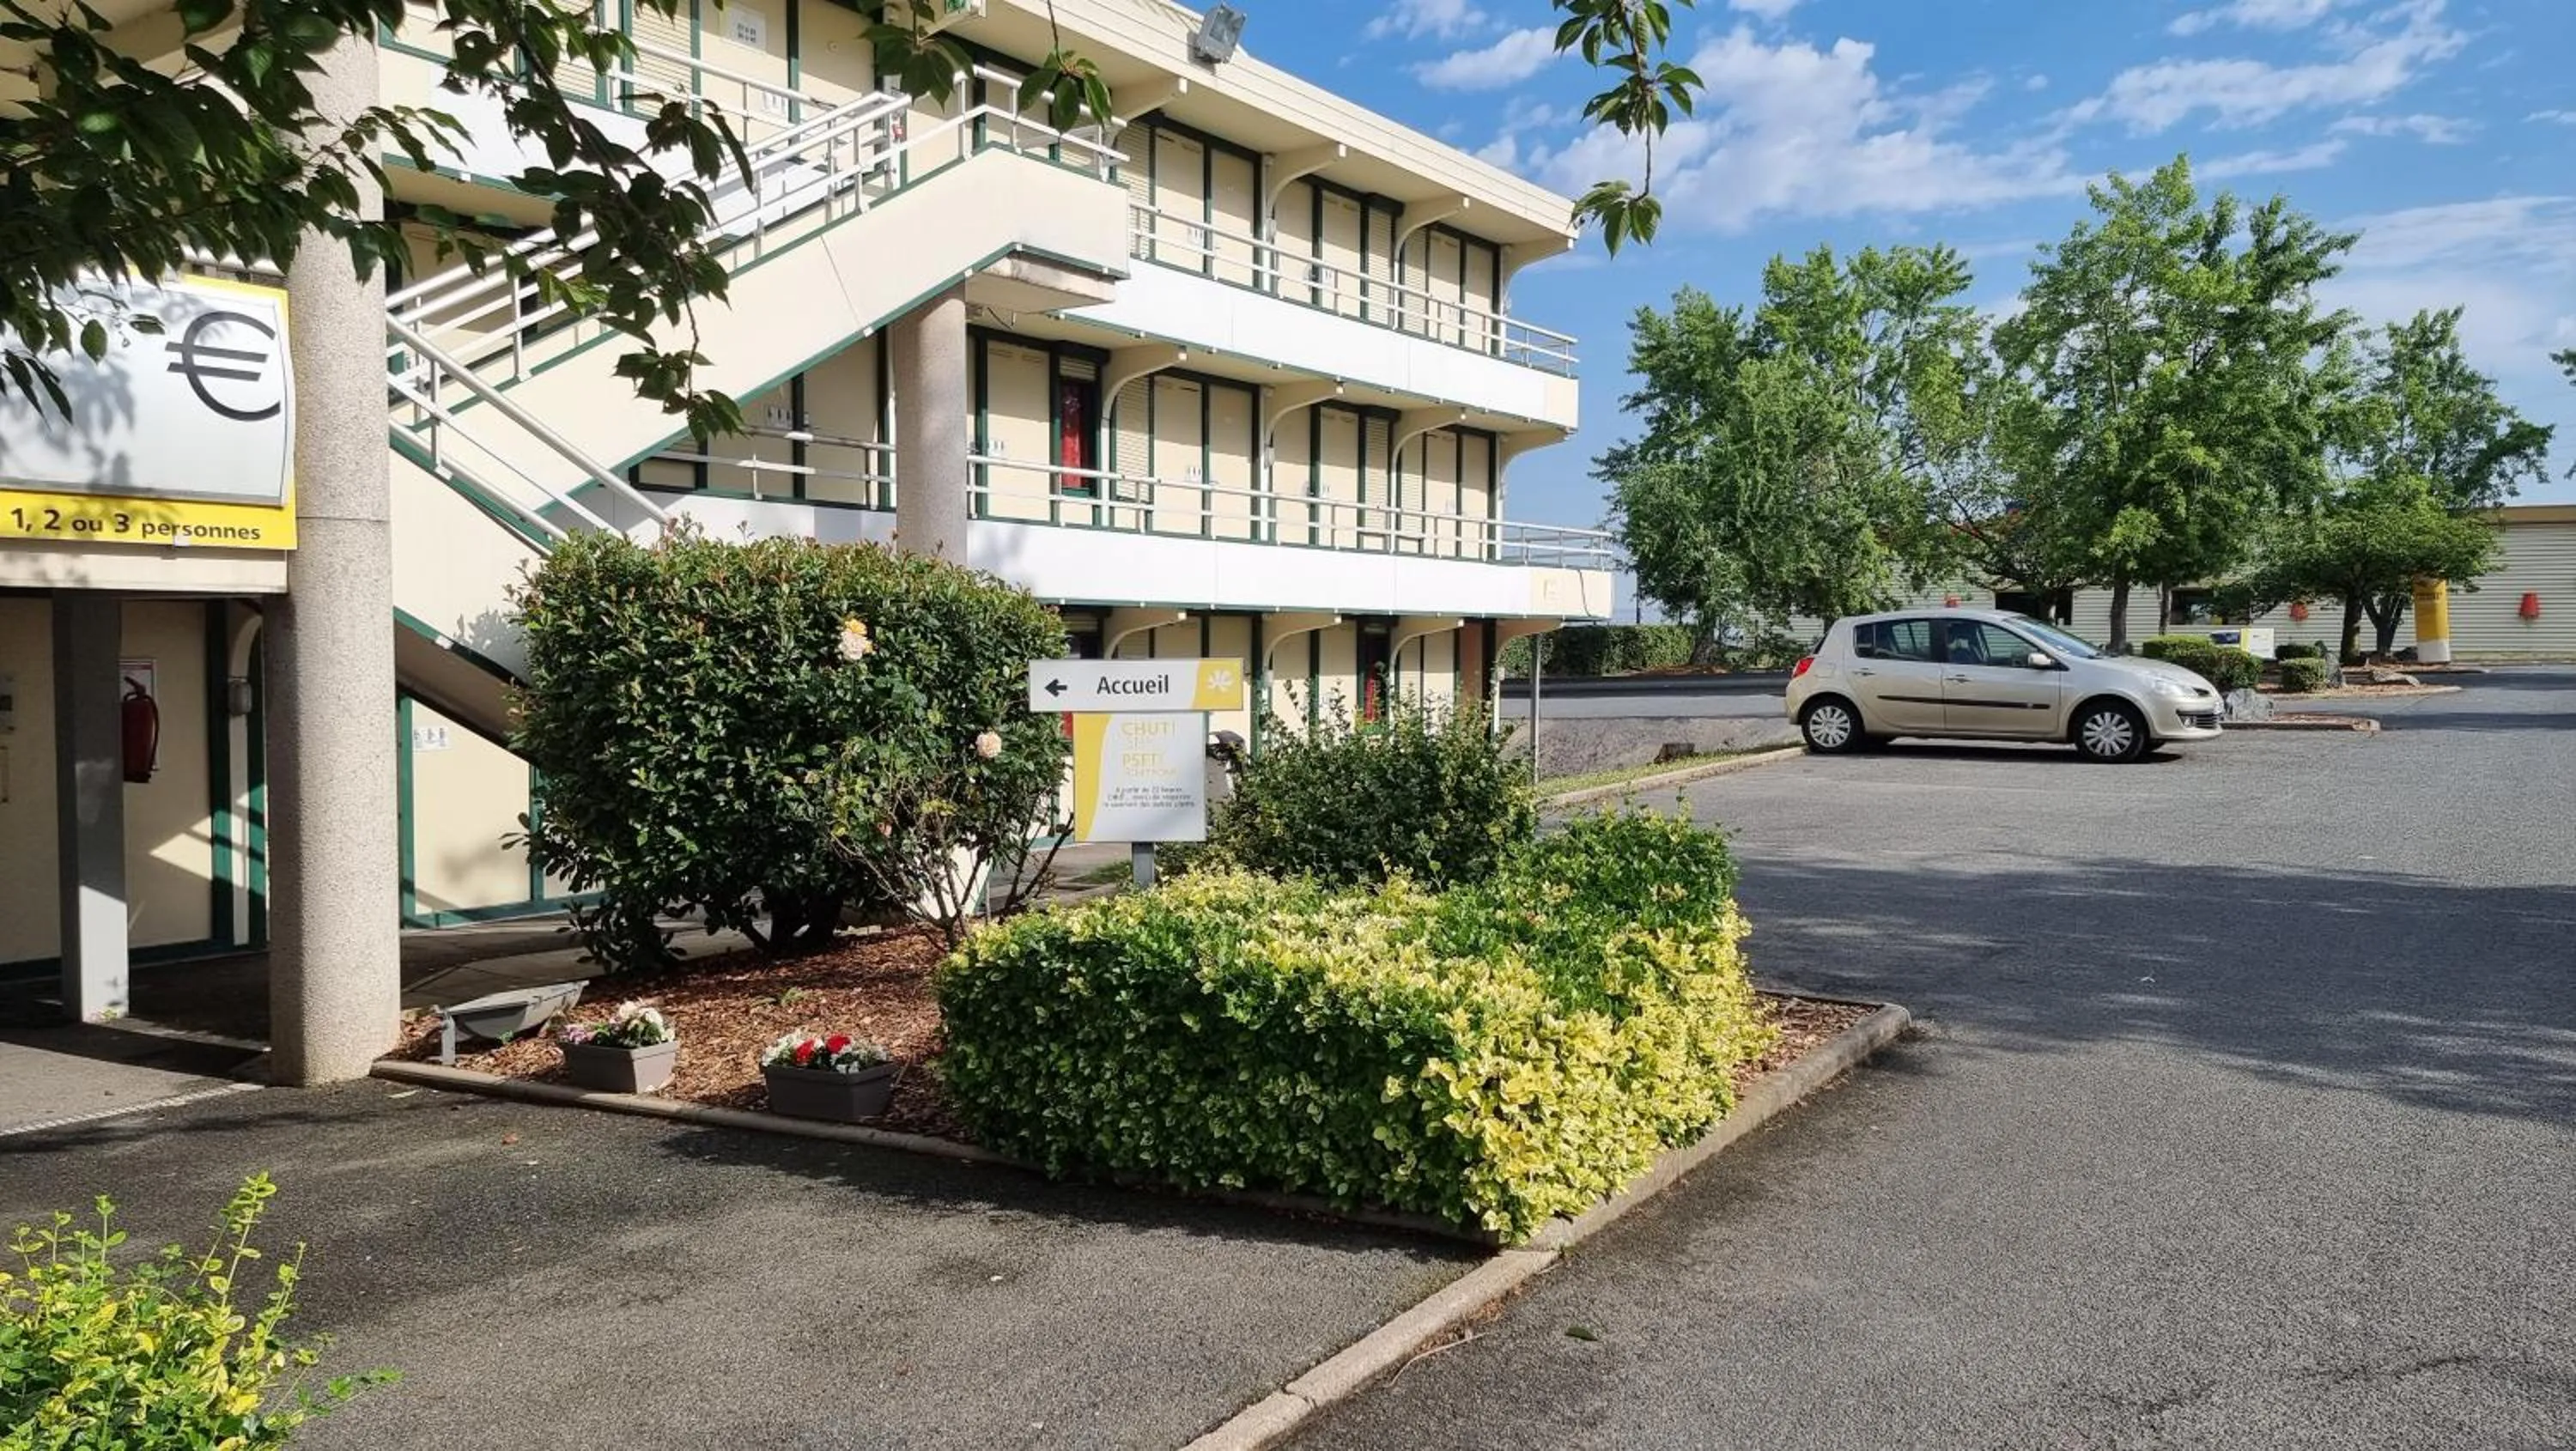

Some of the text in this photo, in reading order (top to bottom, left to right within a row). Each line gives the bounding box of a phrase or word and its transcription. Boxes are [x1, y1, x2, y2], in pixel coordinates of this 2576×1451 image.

[11, 507, 261, 540] 1, 2 ou 3 personnes
[1097, 674, 1170, 695] Accueil
